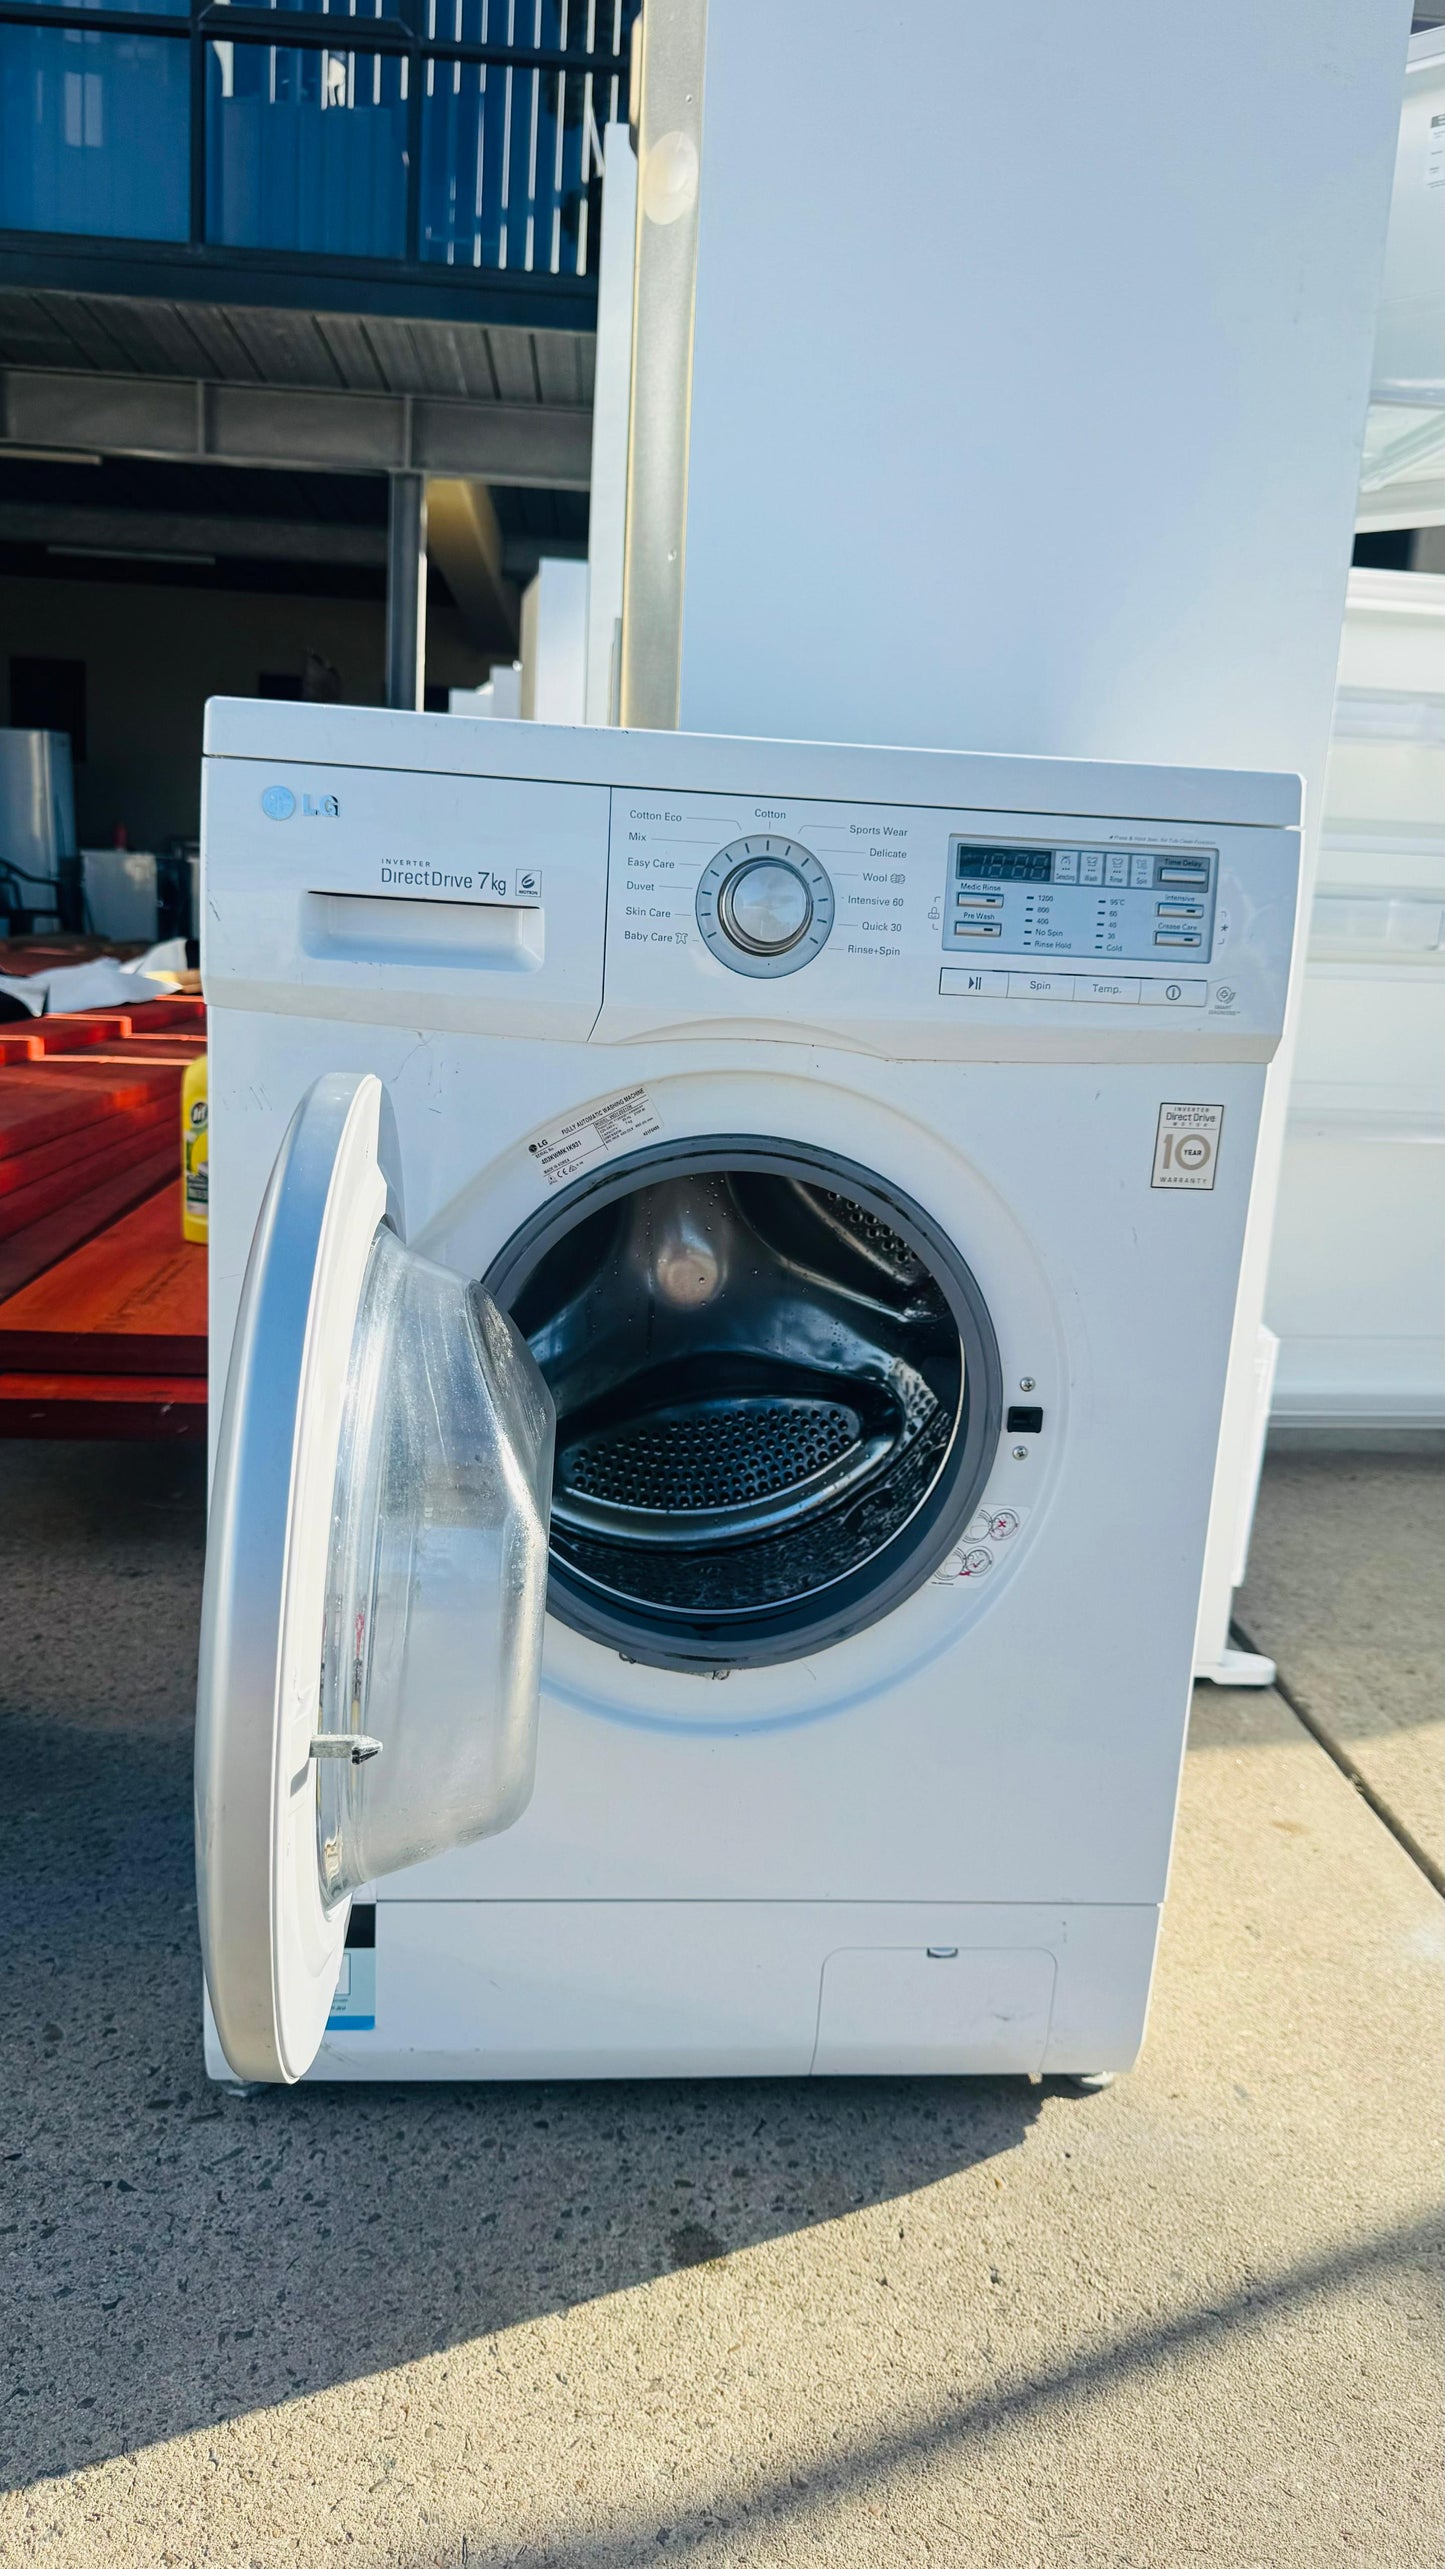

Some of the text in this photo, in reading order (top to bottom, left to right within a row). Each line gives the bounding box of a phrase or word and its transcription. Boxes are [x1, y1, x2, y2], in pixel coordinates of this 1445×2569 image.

[303, 794, 340, 817] LG
[630, 810, 682, 822] Cotton Eco
[754, 808, 786, 819] Cotton
[628, 832, 647, 841] Mix
[849, 825, 908, 837] Sports Wear
[869, 848, 908, 859] Delicate
[381, 858, 431, 867] INVERTER
[627, 858, 675, 869] Easy Care
[1165, 858, 1204, 868] Time Delay
[862, 873, 888, 882] Wool
[626, 881, 655, 891] Duvet
[960, 882, 1001, 892] Medic Rinse
[848, 895, 904, 907] Intensive 60
[1165, 894, 1196, 902] Intensive
[625, 906, 671, 918] Skin Care
[862, 922, 902, 932] Quick 30
[1158, 922, 1198, 931] Crease Care
[624, 931, 673, 943] Baby Care
[1035, 928, 1064, 938] No Spin
[848, 944, 901, 957] Rinse+Spin
[1034, 940, 1072, 950] Rinse Hold
[1106, 944, 1123, 952] Cold
[1029, 980, 1051, 993] Spin
[1092, 984, 1122, 995] Temp.
[561, 1124, 577, 1136] FULLY
[576, 1110, 603, 1128] AUTOMATIC
[602, 1098, 624, 1114] WASHING
[623, 1088, 645, 1104] MACHINE
[537, 1138, 549, 1149] LG
[1162, 1134, 1212, 1170] 10
[1160, 1176, 1208, 1184] WARRANTY
